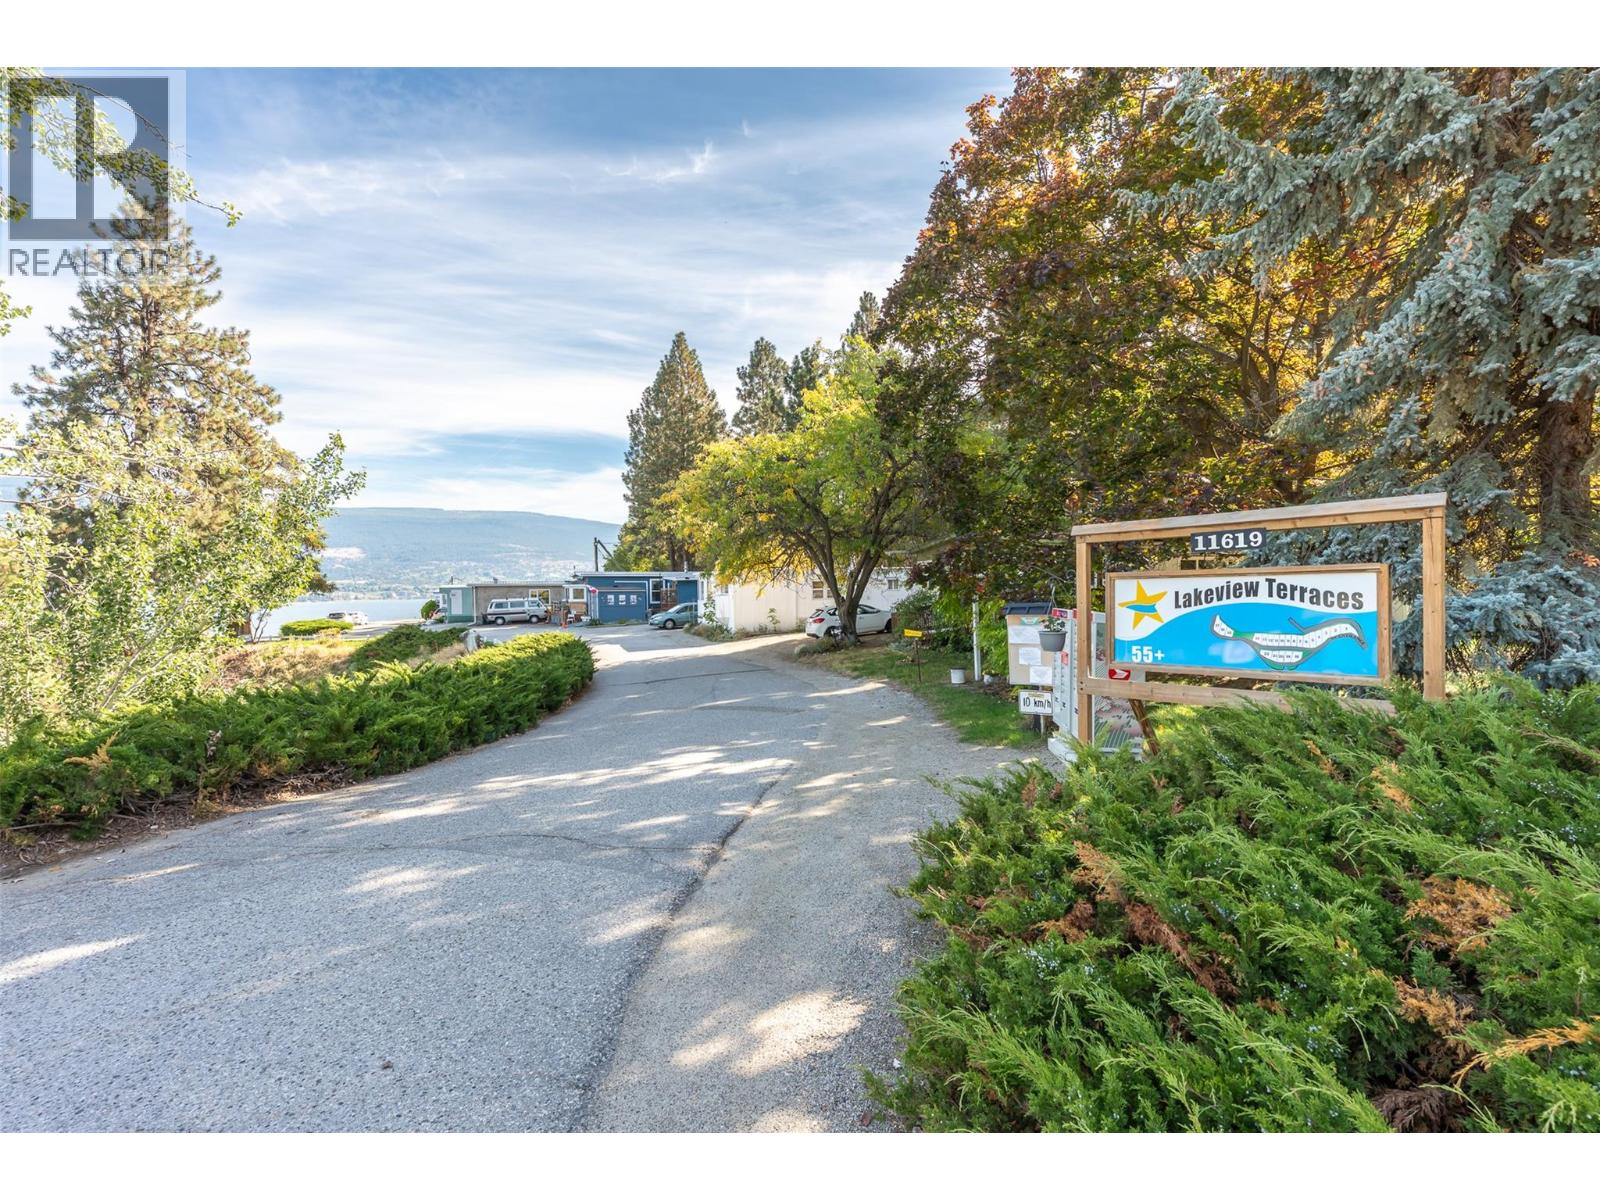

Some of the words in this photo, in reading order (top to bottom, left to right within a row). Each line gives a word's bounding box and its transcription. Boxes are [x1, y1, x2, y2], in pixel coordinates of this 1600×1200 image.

[1194, 531, 1263, 551] 11619
[1174, 580, 1260, 609] Lakeview
[1265, 577, 1364, 611] Terraces
[1131, 645, 1165, 663] 55+
[1023, 697, 1031, 707] 10
[1033, 698, 1052, 710] km/h
